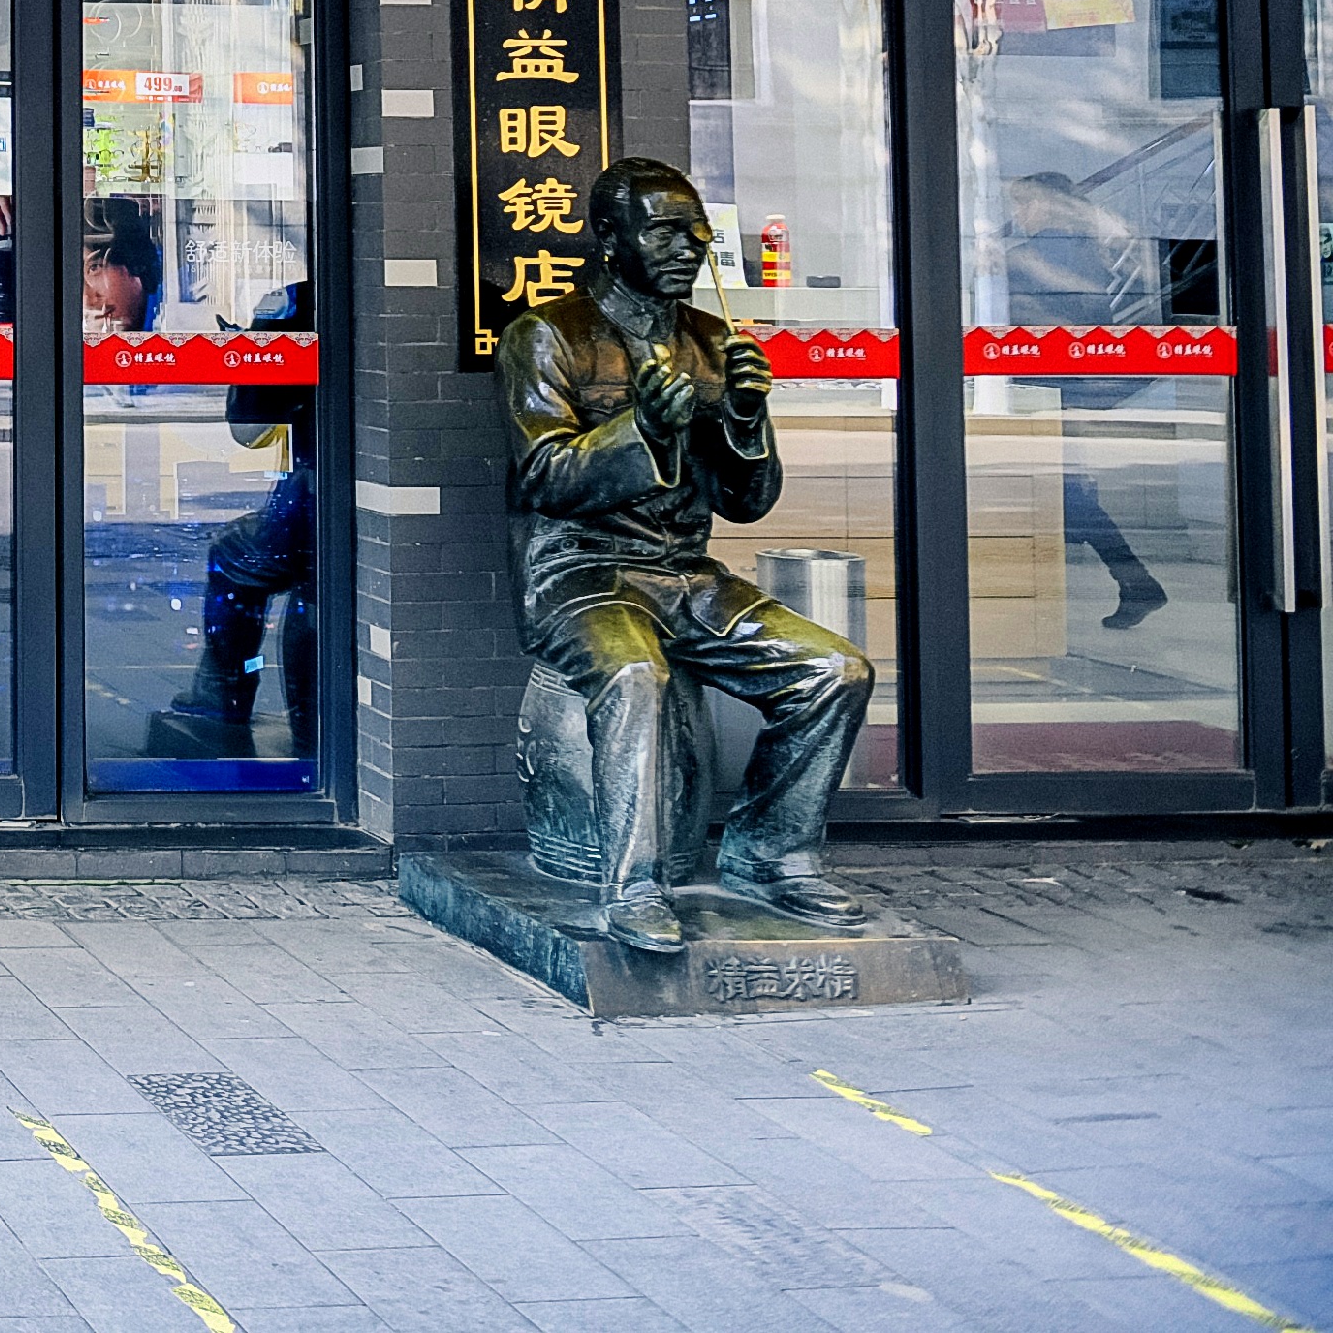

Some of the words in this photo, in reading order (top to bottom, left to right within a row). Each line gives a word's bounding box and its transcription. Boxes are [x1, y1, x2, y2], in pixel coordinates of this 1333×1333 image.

[185, 240, 298, 264] 舒适新体验
[705, 954, 861, 1003] 精益求精
